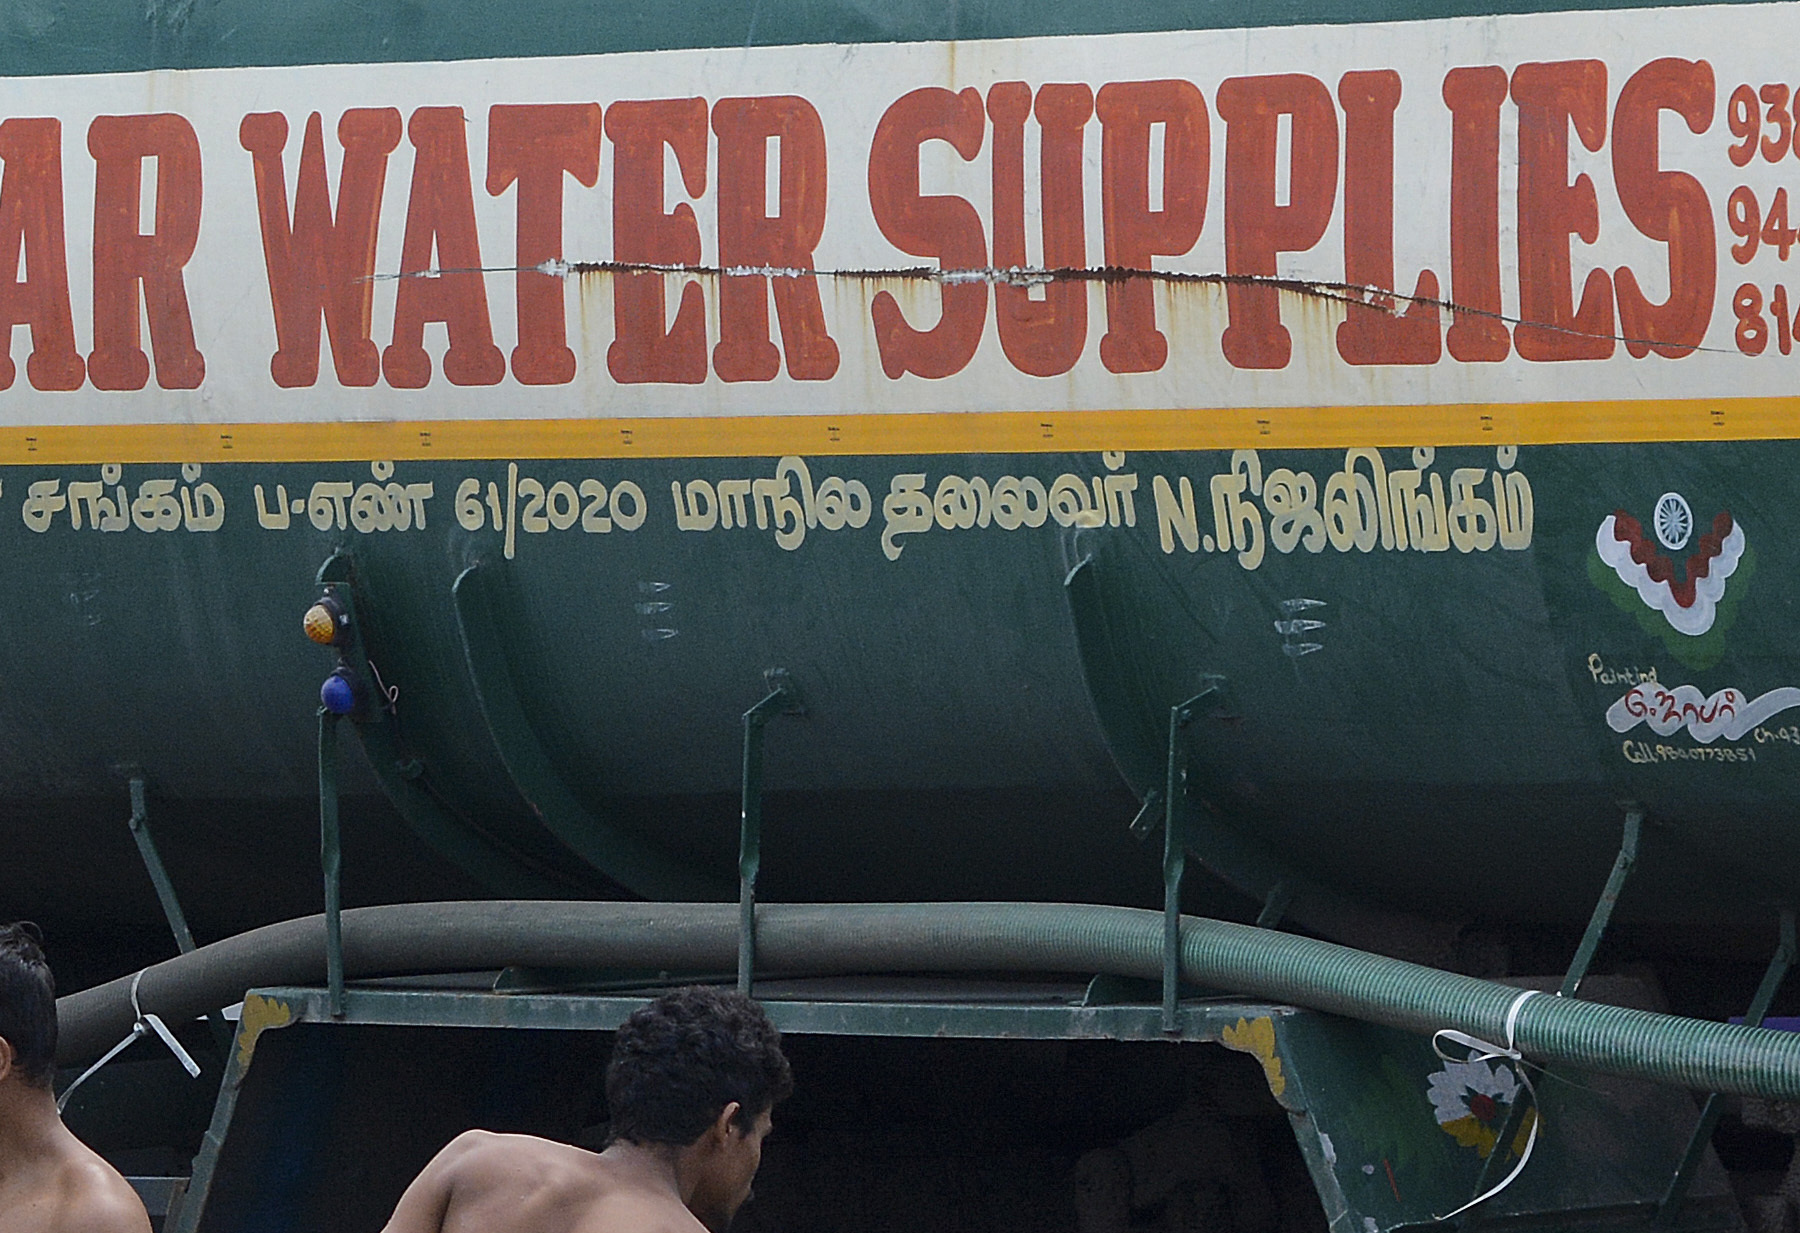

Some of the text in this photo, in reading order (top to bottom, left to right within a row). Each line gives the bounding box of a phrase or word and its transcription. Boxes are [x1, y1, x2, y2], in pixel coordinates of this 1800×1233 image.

[1727, 84, 1800, 167] 93
[239, 95, 840, 388] WATER
[868, 57, 1716, 380] SUPPLIES
[22, 461, 225, 533] சங்கம்
[455, 461, 648, 559] 61/2020
